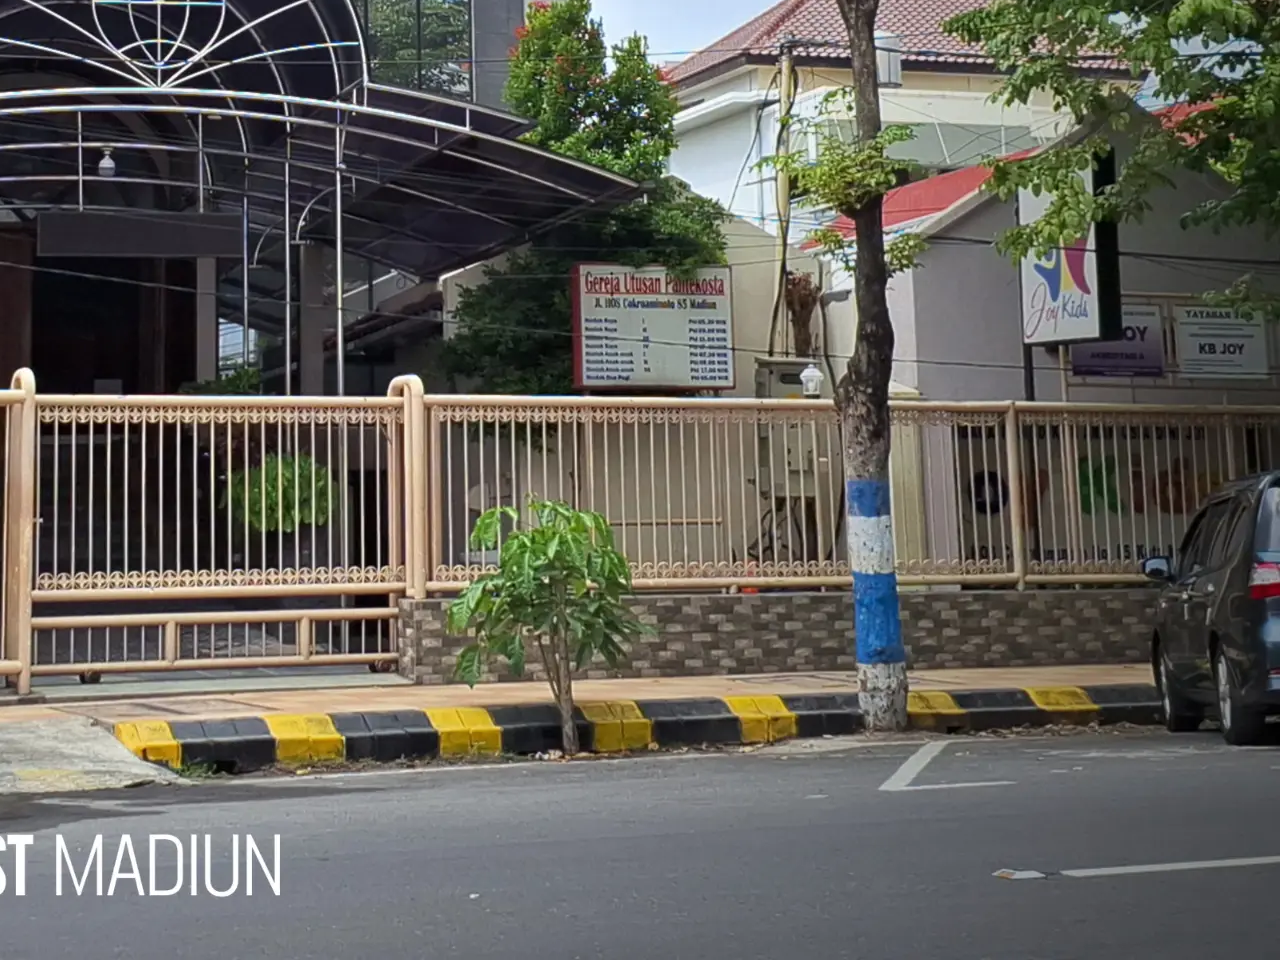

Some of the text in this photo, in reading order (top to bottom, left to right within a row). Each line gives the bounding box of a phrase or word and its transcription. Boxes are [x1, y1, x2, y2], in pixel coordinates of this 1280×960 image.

[585, 271, 620, 296] Gereja
[624, 271, 661, 293] Utusan
[1025, 282, 1089, 339] Joy Kids
[1124, 326, 1148, 342] OY
[1198, 342, 1245, 355] KB JOY
